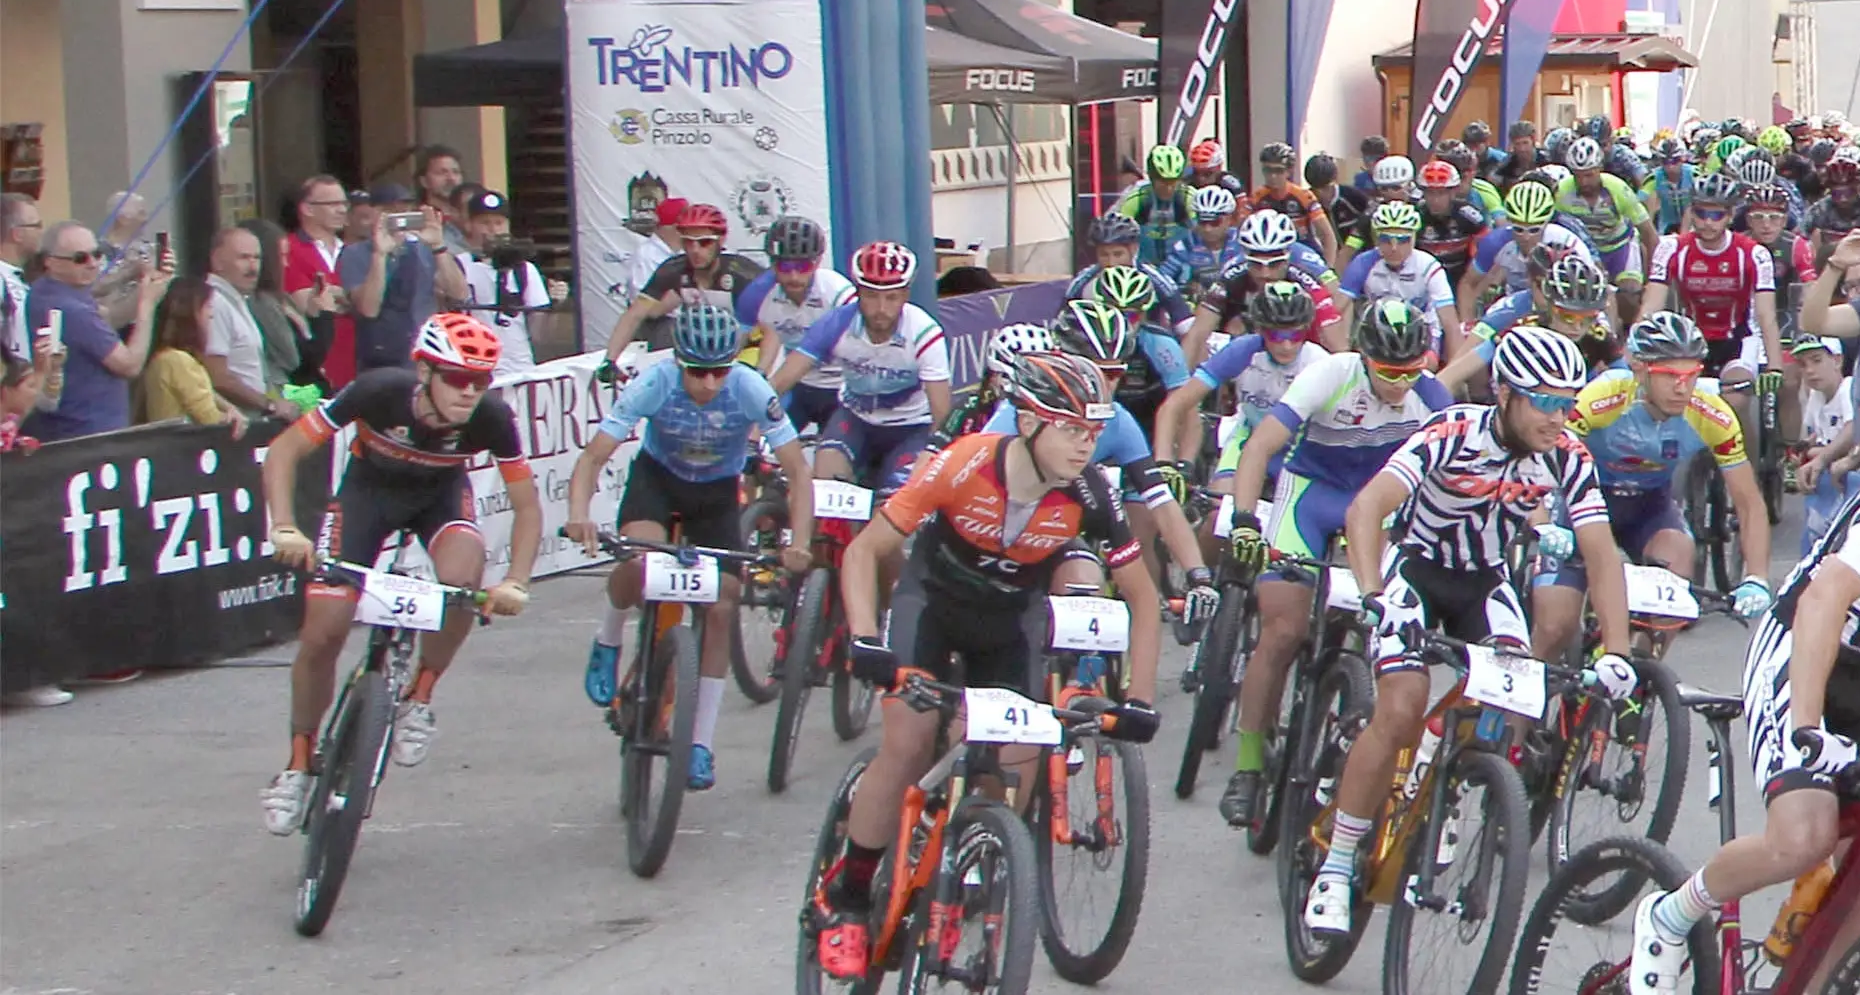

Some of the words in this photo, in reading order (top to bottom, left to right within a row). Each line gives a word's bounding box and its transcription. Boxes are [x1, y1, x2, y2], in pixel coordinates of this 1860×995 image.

[588, 36, 794, 94] TRENTINO
[966, 68, 1036, 92] FOCUS
[651, 108, 700, 125] Cassa
[702, 109, 755, 125] Rurale
[651, 129, 713, 145] Pinzolo
[826, 493, 856, 508] 114
[668, 572, 702, 591] 115
[1655, 584, 1677, 604] 12
[393, 597, 418, 616] 56
[1087, 616, 1100, 636] 4
[1502, 673, 1515, 693] 3
[1003, 706, 1031, 726] 41
